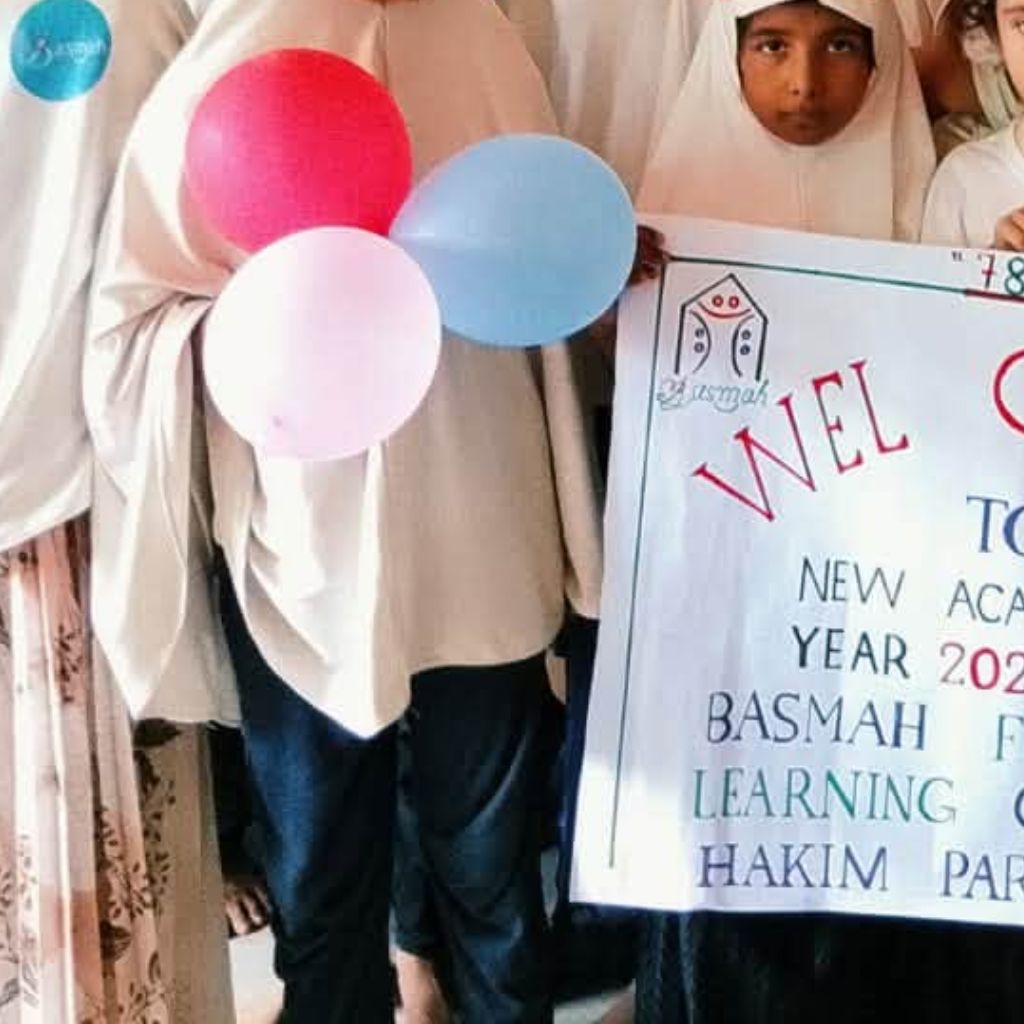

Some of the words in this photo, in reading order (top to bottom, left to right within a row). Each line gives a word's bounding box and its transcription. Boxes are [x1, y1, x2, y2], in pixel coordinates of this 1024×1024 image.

[692, 360, 910, 522] WEL
[798, 555, 906, 609] NEW
[791, 624, 911, 680] YEAR
[705, 689, 928, 751] BASMAH
[692, 767, 958, 826] LEARNING
[695, 842, 889, 893] HAKIM
